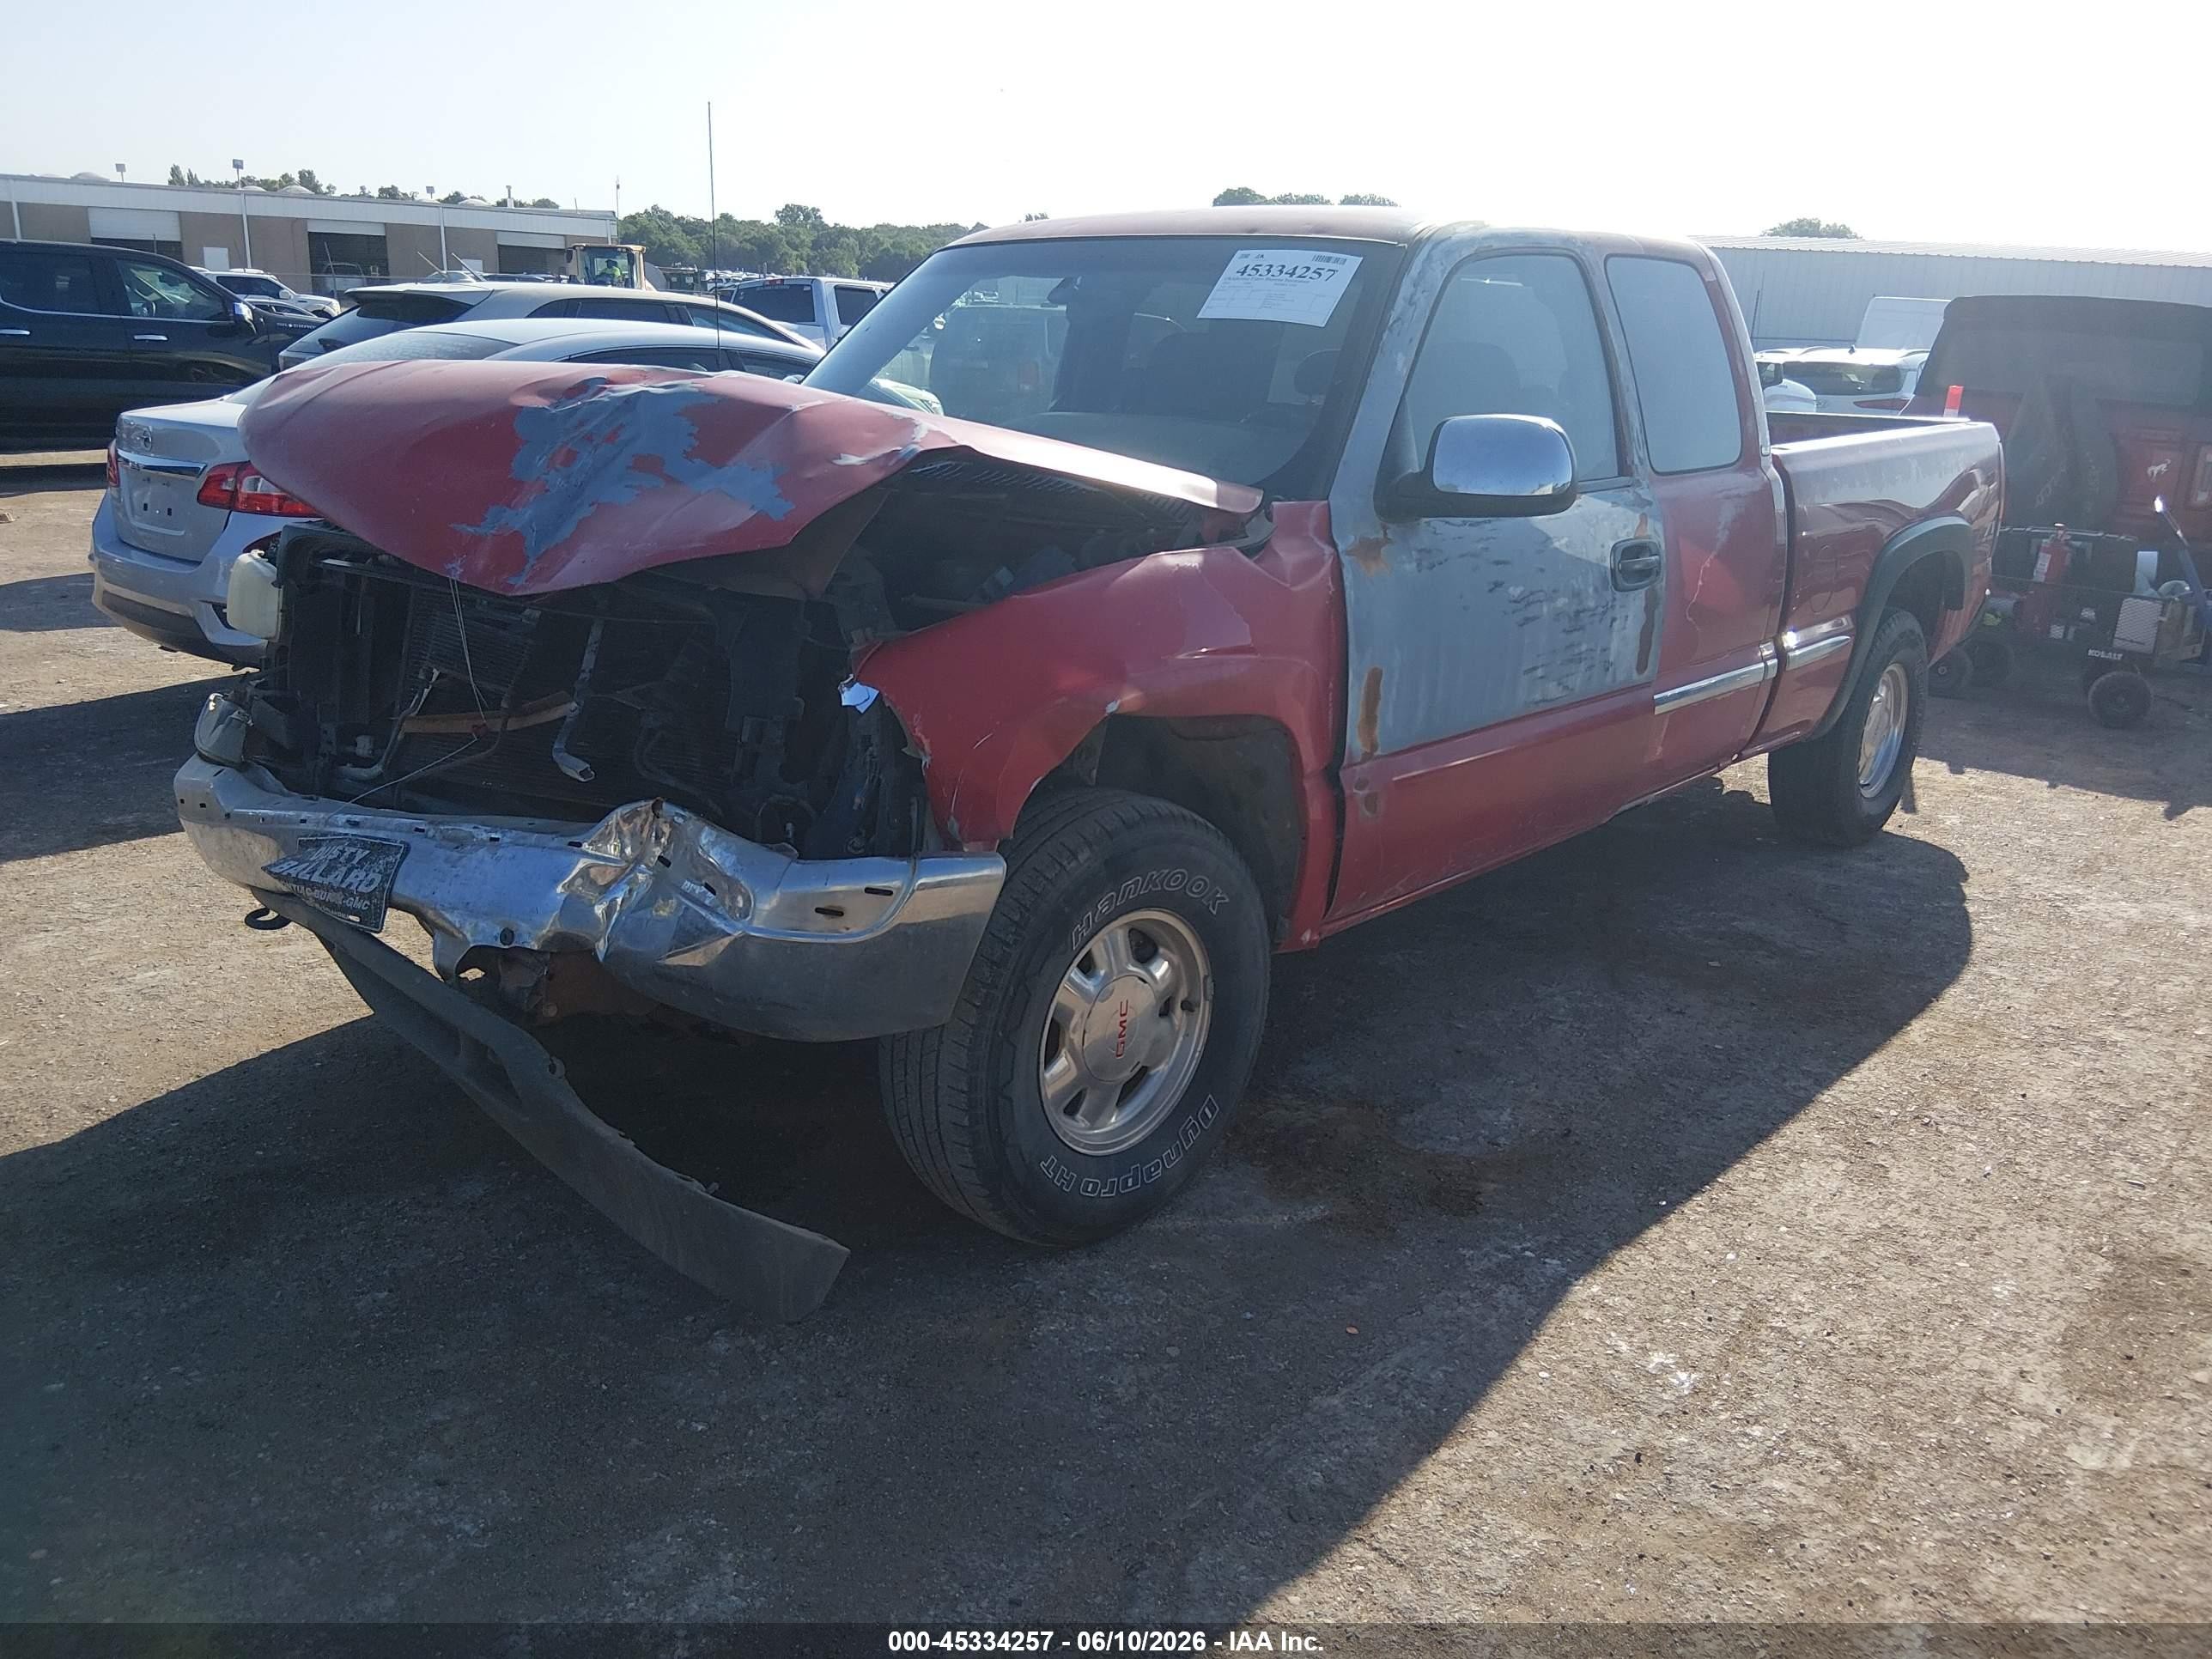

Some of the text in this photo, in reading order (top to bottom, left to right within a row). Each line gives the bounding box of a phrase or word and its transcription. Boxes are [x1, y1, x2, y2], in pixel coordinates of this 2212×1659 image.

[1236, 264, 1339, 282] 45334257
[269, 860, 382, 894] BALLARD
[1116, 999, 1128, 1059] GMC
[1040, 1093, 1220, 1197] Dynapro HT
